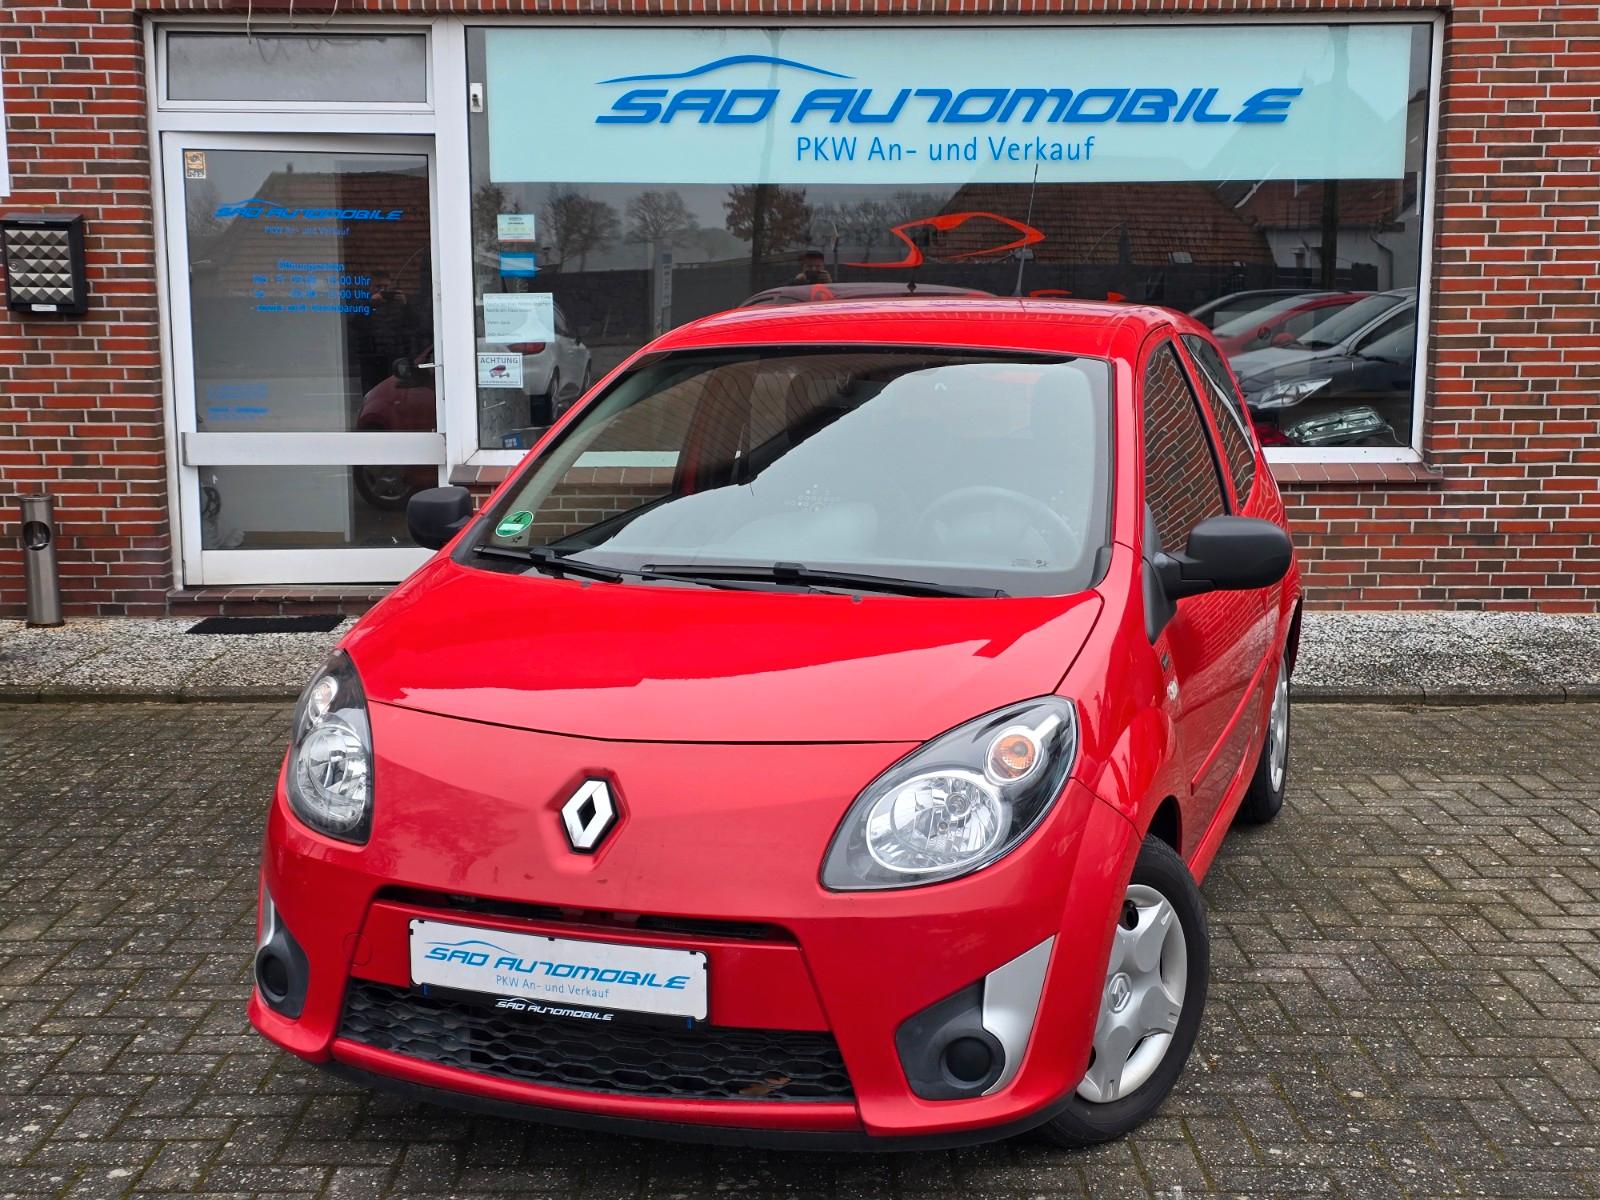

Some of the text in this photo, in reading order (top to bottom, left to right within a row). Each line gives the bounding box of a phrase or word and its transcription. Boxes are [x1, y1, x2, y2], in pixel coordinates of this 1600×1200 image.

[595, 88, 1304, 124] SAD AUTOMOBILE
[797, 136, 1096, 161] PKW An- und Verkauf
[265, 208, 404, 220] AUTOMOBILE
[354, 276, 371, 286] Uhr
[354, 290, 371, 299] Uhr
[480, 356, 519, 364] ACHTUNG
[425, 947, 691, 989] SAD AUTOMOBILE
[496, 974, 609, 999] PKW An- und Verkauf
[496, 1000, 614, 1021] SAD AUTOMOBILE
